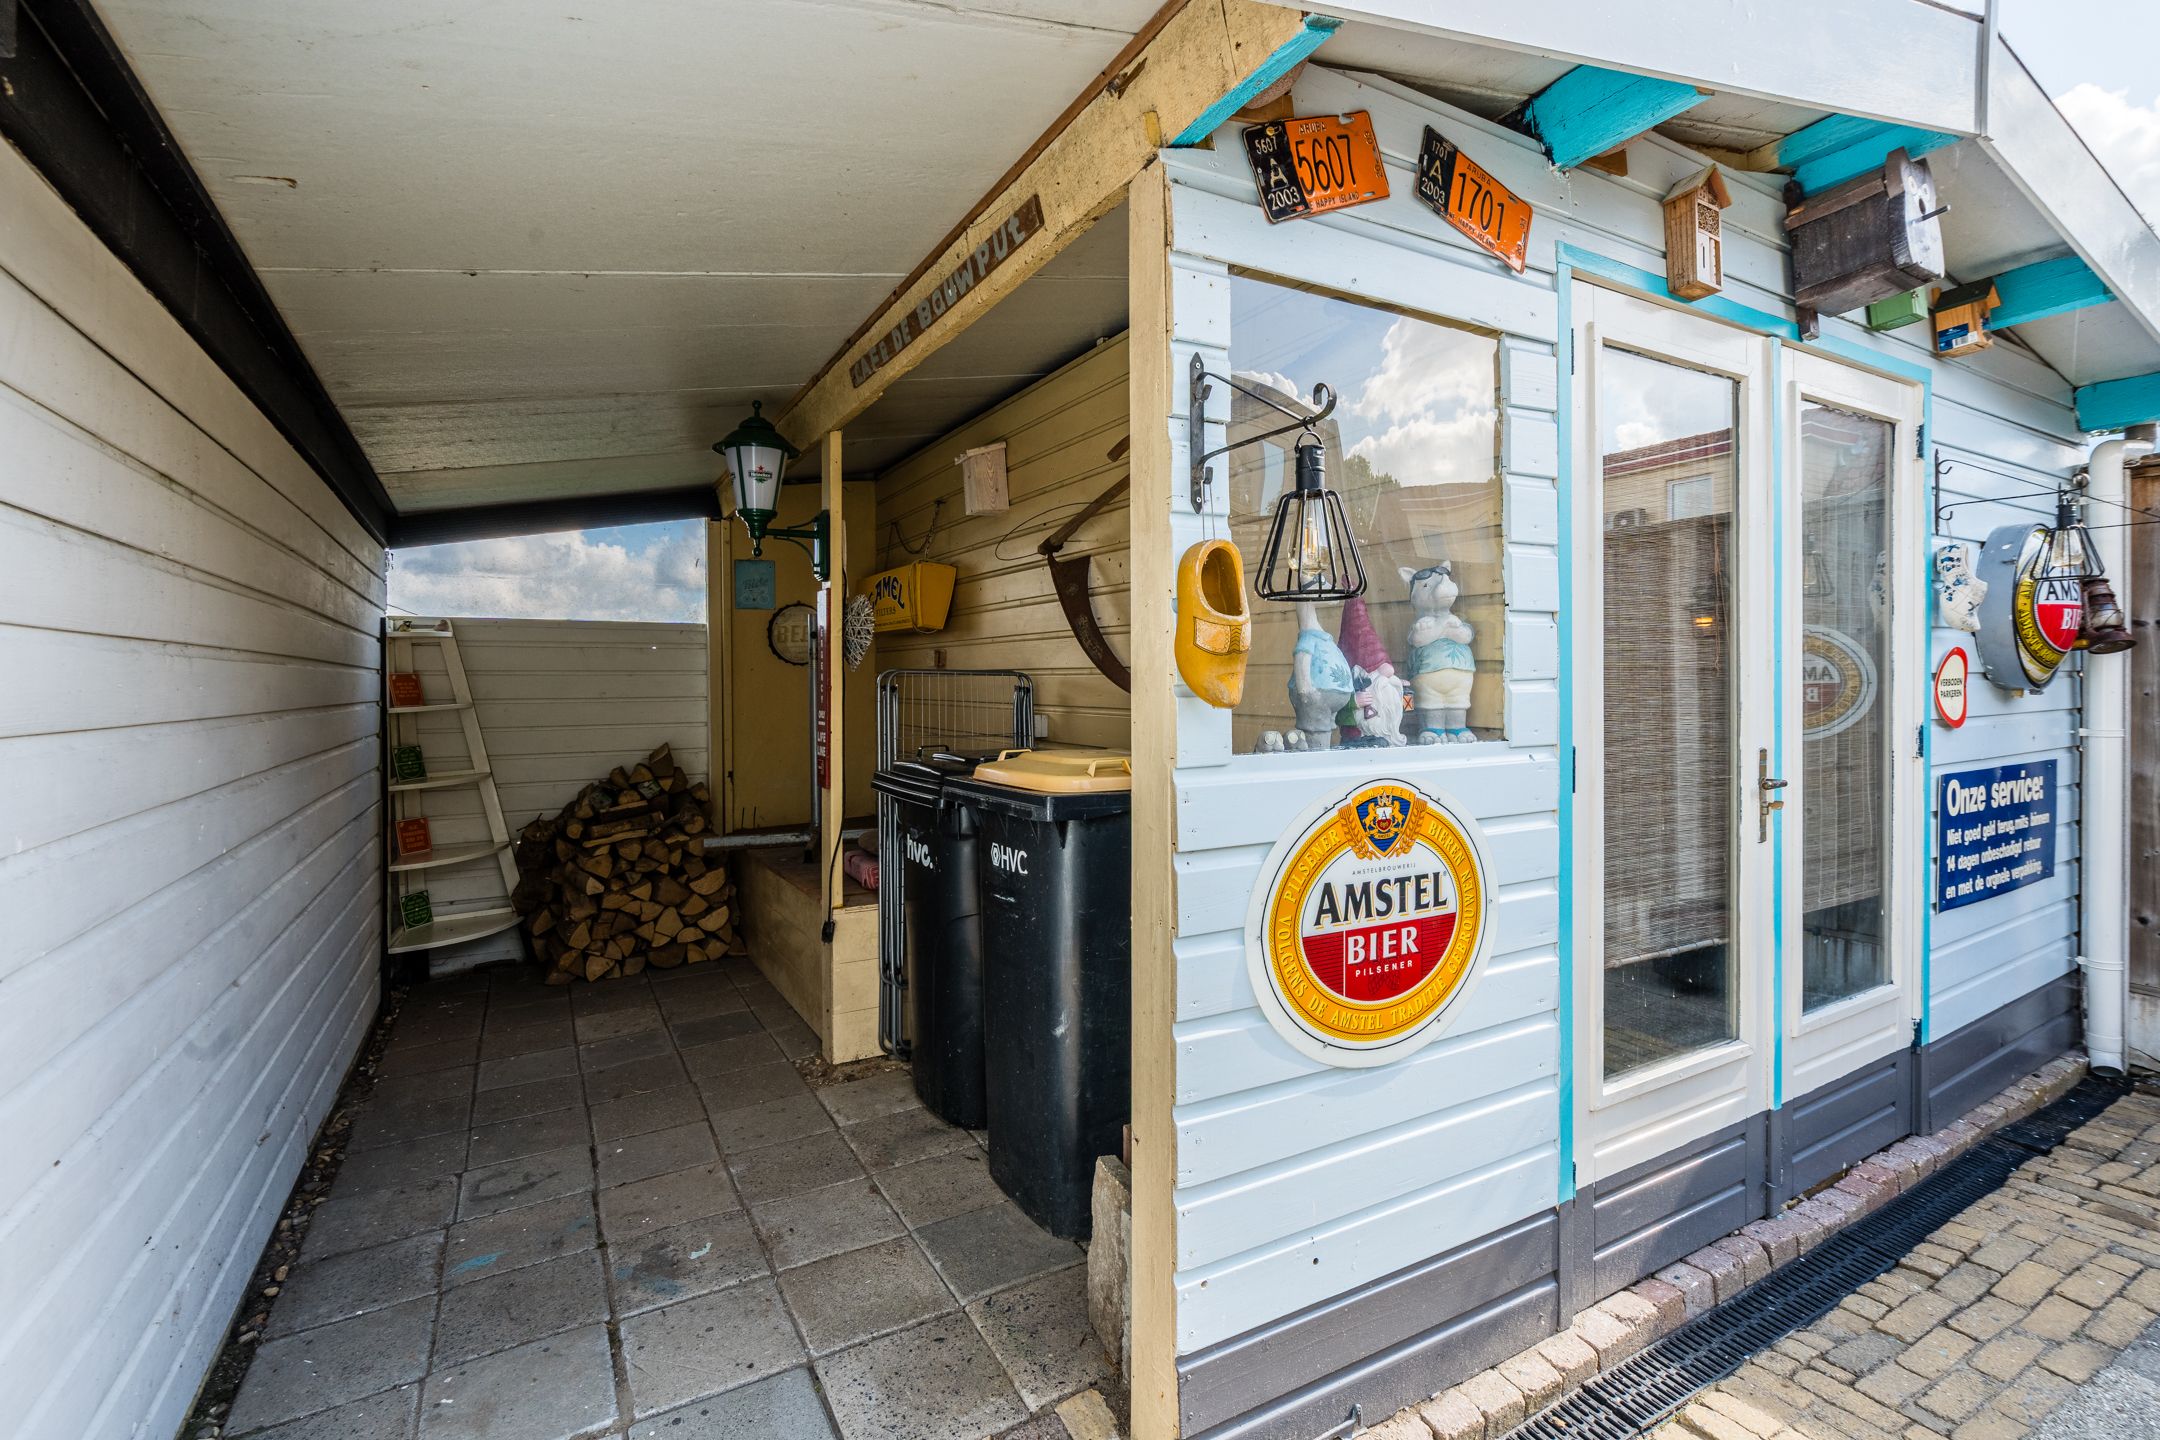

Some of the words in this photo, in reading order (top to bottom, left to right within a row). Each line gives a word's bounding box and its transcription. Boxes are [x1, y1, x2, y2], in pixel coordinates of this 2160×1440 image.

[1298, 121, 1327, 135] ARUBA
[1255, 137, 1278, 155] 5607
[1432, 140, 1448, 161] 1701
[1269, 158, 1288, 189] A
[1295, 134, 1356, 196] 5607
[1429, 159, 1443, 187] A
[1466, 163, 1491, 186] ARUBA
[1267, 186, 1301, 211] 2003
[1315, 196, 1336, 209] HAPPY
[1338, 191, 1360, 204] ISLAND
[1421, 176, 1446, 205] 2003
[1457, 172, 1505, 243] 1701
[1458, 216, 1476, 234] HAPPY
[1477, 229, 1496, 250] ISLAND
[891, 318, 913, 351] DE
[2045, 580, 2080, 601] AMS
[1940, 677, 1963, 688] VERBODEN
[1940, 689, 1962, 699] PARKEREN
[1946, 779, 1987, 817] Onze
[1991, 770, 2044, 809] service:
[1946, 829, 1962, 846] Niet
[1964, 824, 1981, 846] goed
[1982, 820, 1996, 841] geld
[2030, 812, 2050, 827] binnen
[1000, 844, 1029, 875] HVC
[1284, 828, 1341, 905] PILSENER
[1428, 820, 1466, 867] BIEREN
[1352, 862, 1416, 876] AMSTELBROUWERIJ
[1946, 855, 1956, 872] 14
[1958, 854, 1980, 871] dagen
[1981, 838, 2023, 863] onbeschadigd
[2024, 837, 2042, 852] retour
[1313, 870, 1449, 927] AMSTEL
[1946, 885, 1956, 899] en
[1958, 878, 1974, 896] met
[1975, 875, 1985, 891] de
[1277, 915, 1309, 998] VOLGENS
[1308, 994, 1328, 1019] DE
[1330, 1010, 1383, 1031] AMSTEL
[1391, 976, 1448, 1022] TRADITIE
[1447, 871, 1475, 975] GEBROUWEN
[1346, 926, 1419, 965] BIER
[1355, 959, 1414, 977] PILSENER
